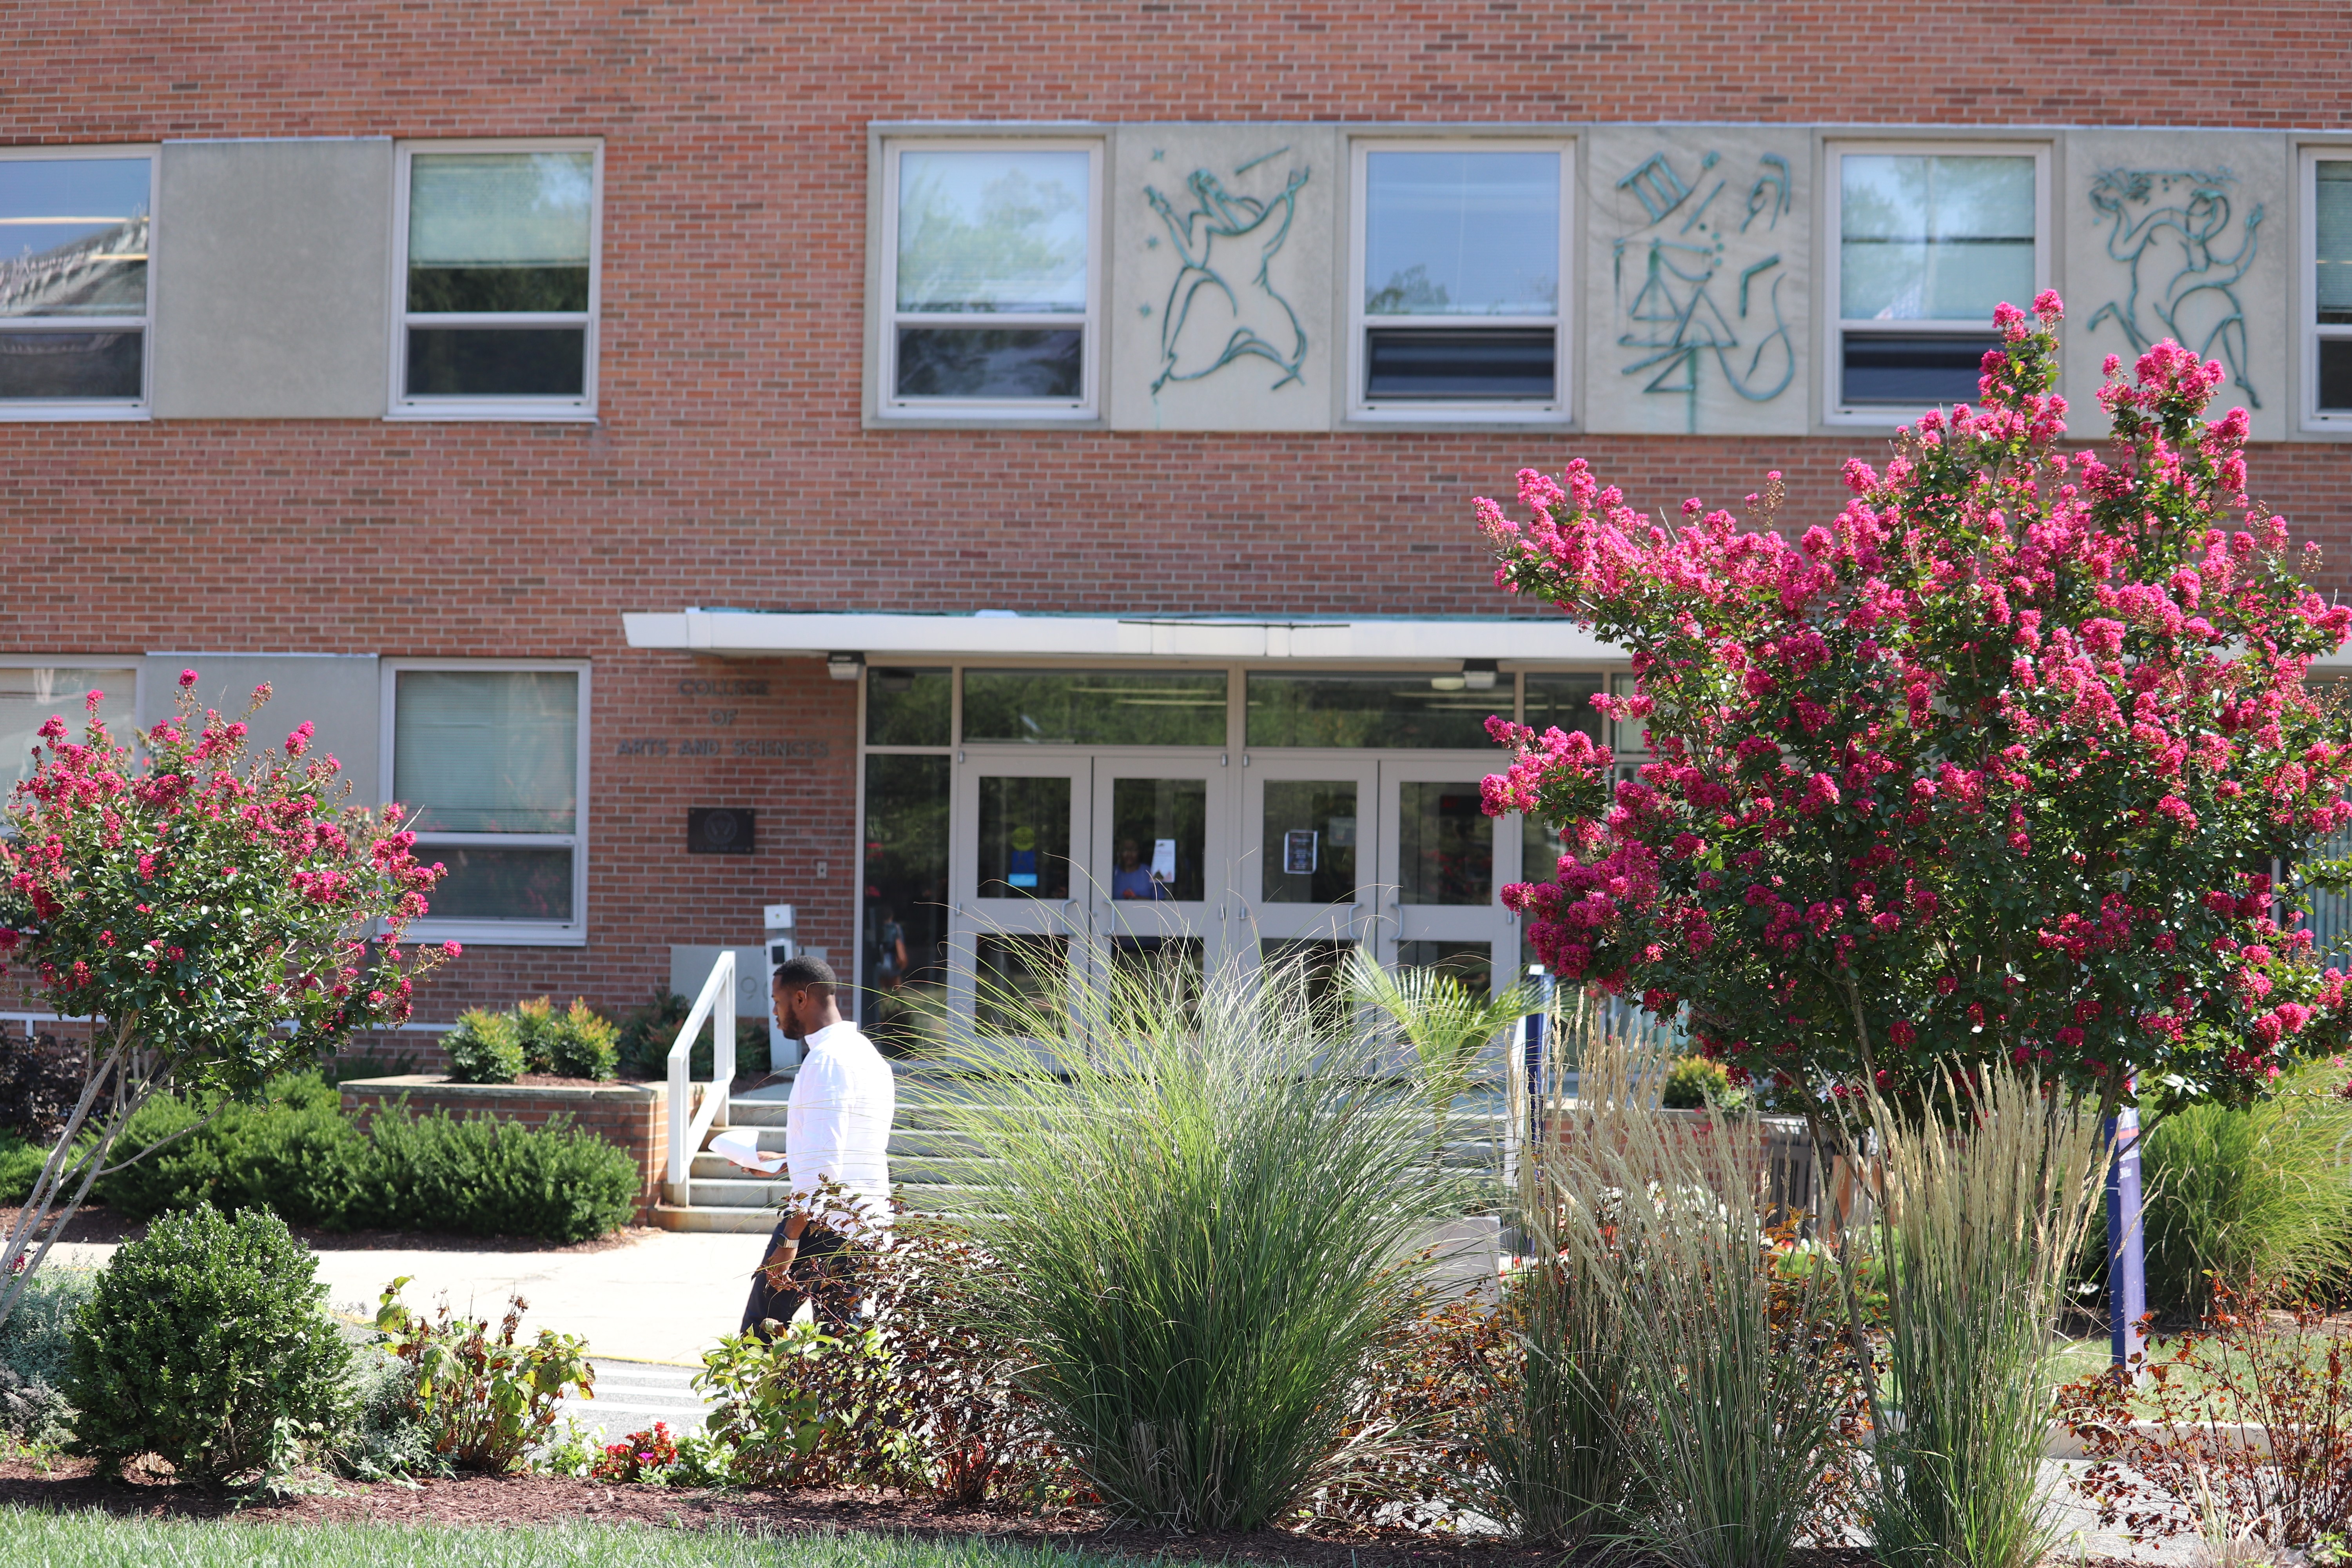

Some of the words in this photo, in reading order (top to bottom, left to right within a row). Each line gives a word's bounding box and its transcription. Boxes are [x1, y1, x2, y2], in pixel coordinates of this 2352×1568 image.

[679, 679, 770, 696] COLLEGE
[709, 709, 738, 726] OF
[617, 739, 668, 756] ARTS
[678, 739, 719, 757] AND
[732, 740, 830, 757] SCIENCES
